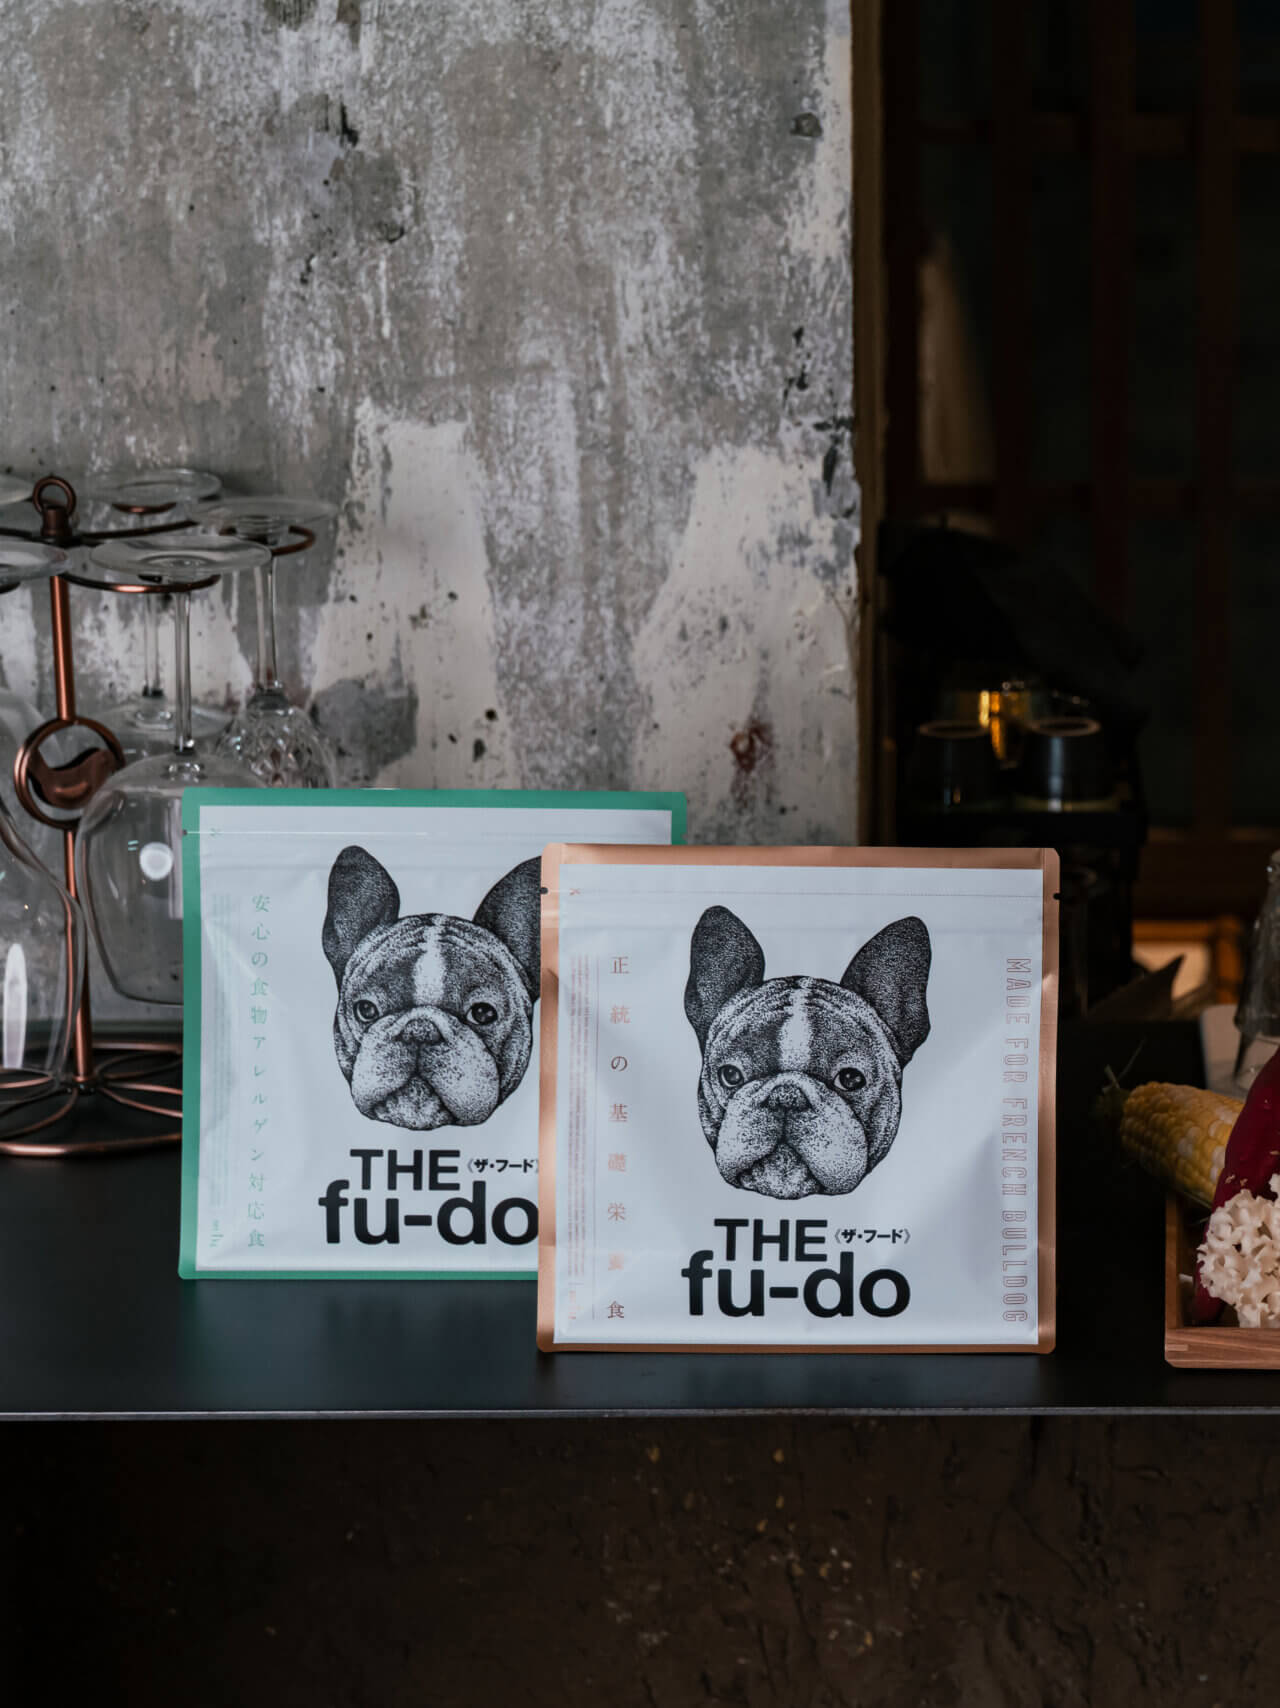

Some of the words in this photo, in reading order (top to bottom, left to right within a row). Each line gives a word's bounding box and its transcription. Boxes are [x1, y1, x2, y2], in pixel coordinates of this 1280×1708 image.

[1006, 957, 1031, 1025] MADE
[1003, 1037, 1029, 1083] FOR
[349, 1149, 461, 1191] THE
[1002, 1097, 1028, 1196] FRENCH
[318, 1179, 539, 1246] fu-do
[713, 1218, 828, 1262] THE
[681, 1249, 911, 1318] fu-do
[1002, 1210, 1028, 1322] BULLDOG
